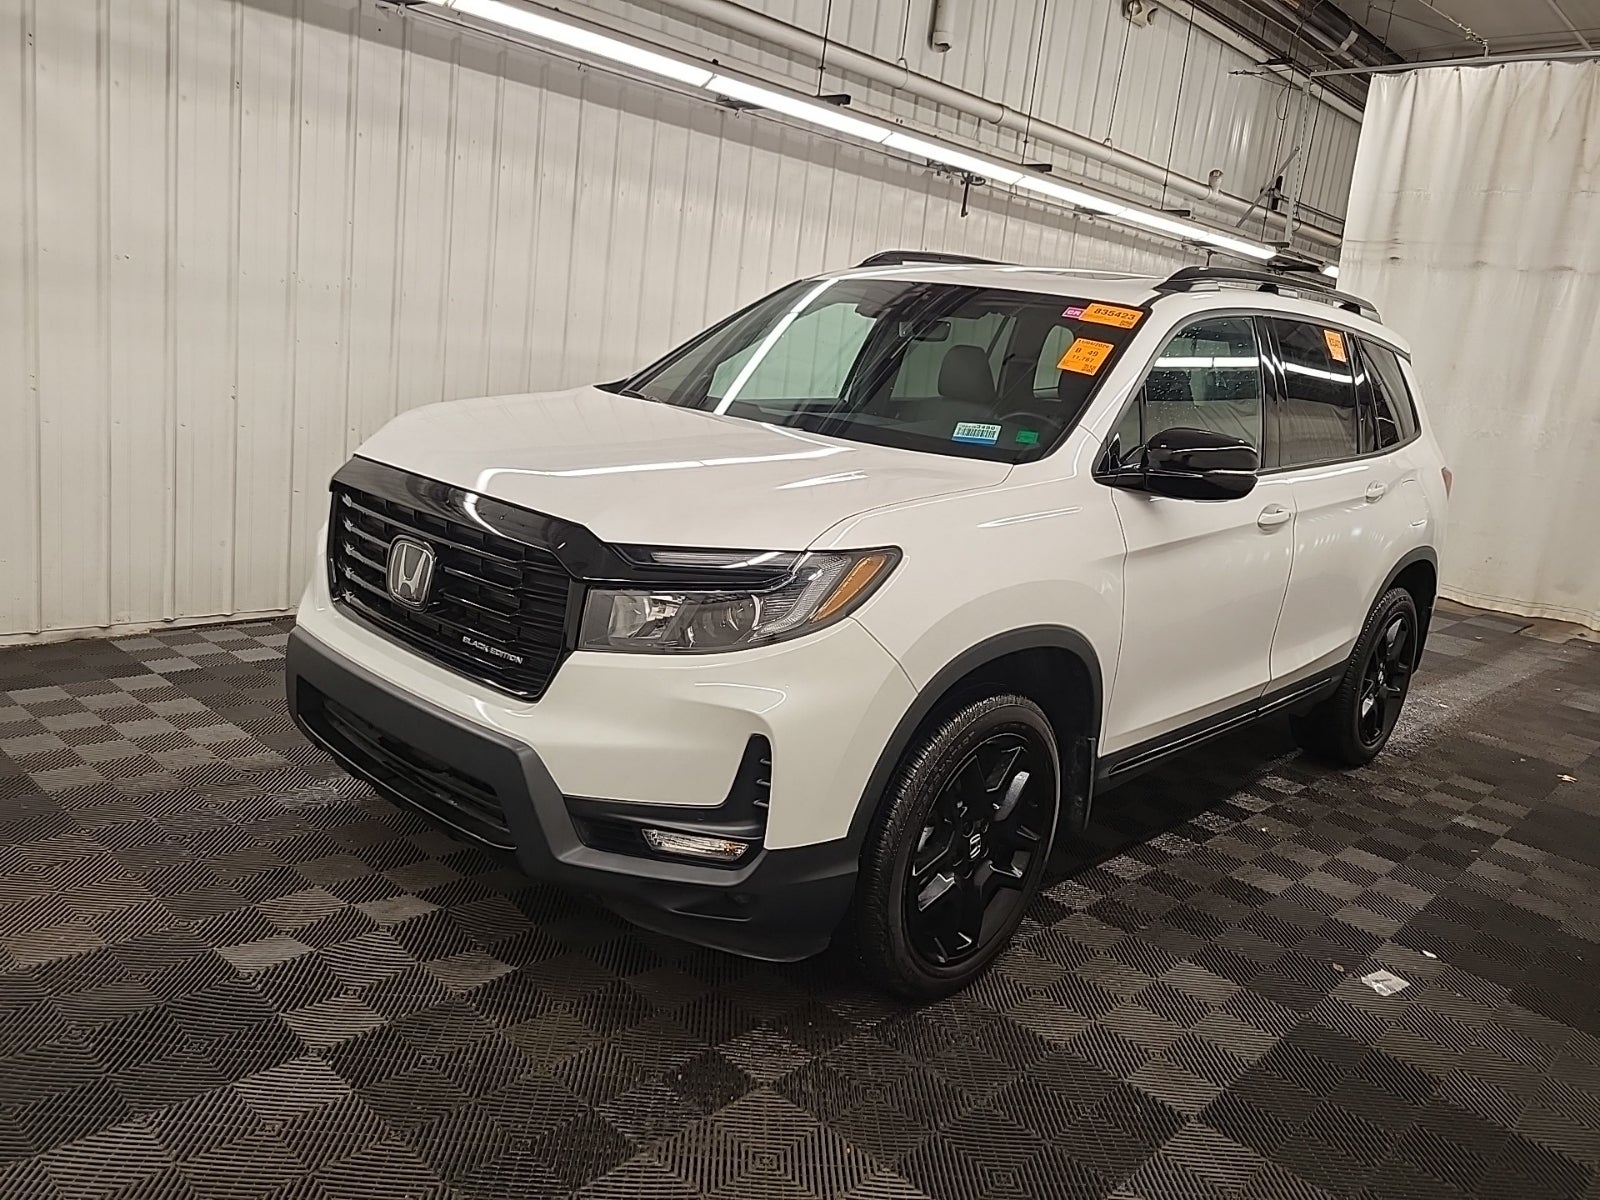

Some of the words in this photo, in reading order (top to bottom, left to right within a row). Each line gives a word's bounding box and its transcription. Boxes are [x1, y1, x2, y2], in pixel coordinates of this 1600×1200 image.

[1094, 308, 1136, 320] 835423
[462, 635, 489, 653] BLACK
[489, 646, 524, 665] EDITION
